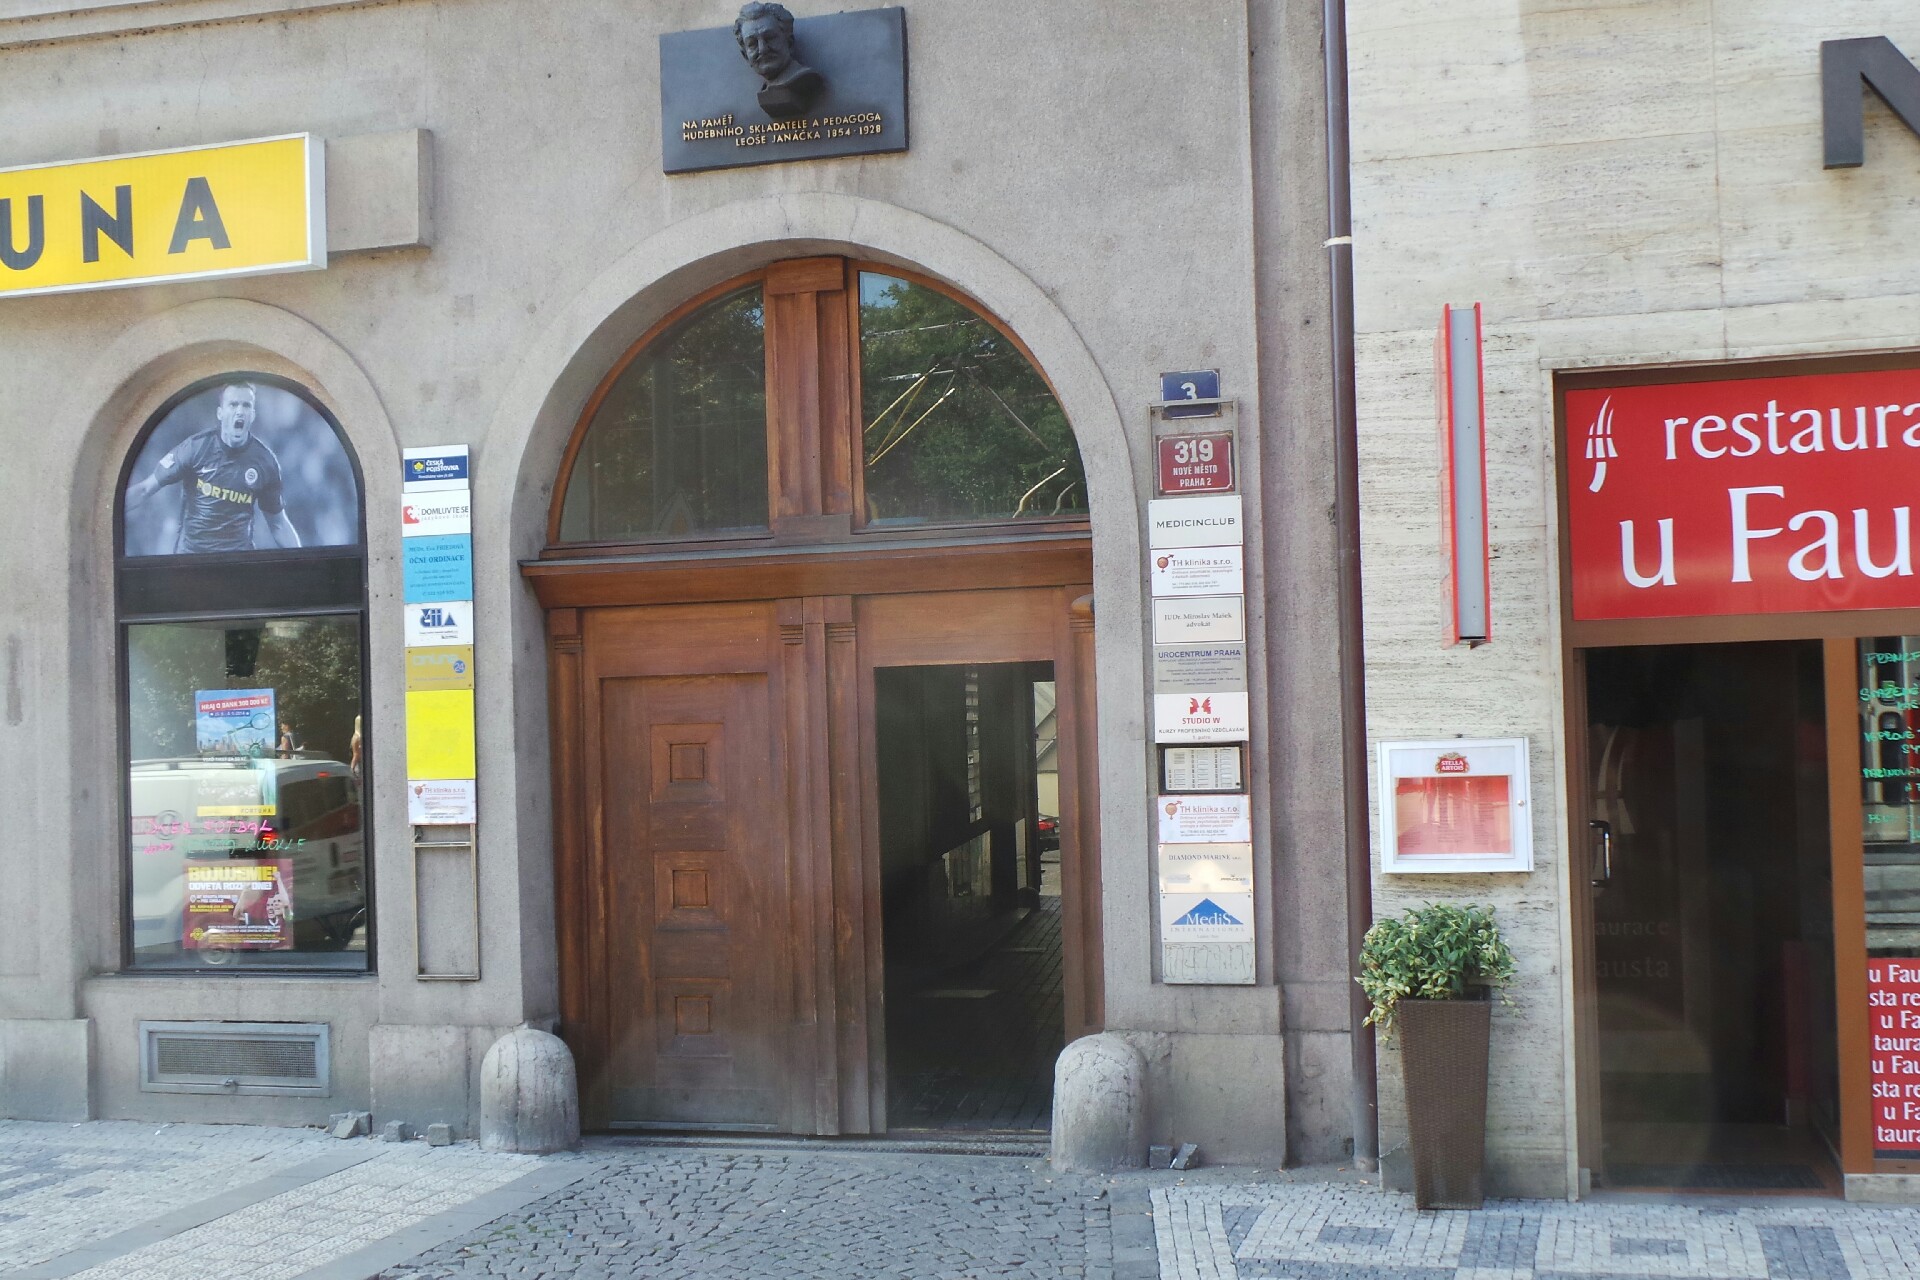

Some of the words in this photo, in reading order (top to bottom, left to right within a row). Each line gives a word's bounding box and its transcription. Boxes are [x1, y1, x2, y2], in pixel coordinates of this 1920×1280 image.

[683, 120, 697, 130] NA
[701, 114, 733, 128] PAMĚŤ
[683, 126, 744, 141] HUDEBNÍHO
[749, 119, 807, 134] SKLADATELE
[812, 118, 819, 127] A
[823, 113, 882, 126] PEDAGOGA
[735, 134, 766, 147] LEOŠE
[772, 130, 821, 143] JANÁČKA
[827, 128, 850, 138] 1854
[859, 125, 882, 135] 1928
[1180, 382, 1198, 400] 3
[1174, 439, 1214, 464] 319
[1173, 464, 1192, 476] NOVÉ
[1194, 463, 1217, 474] MĚSTO
[1180, 478, 1205, 487] PRAHA
[1207, 477, 1212, 486] 2
[196, 478, 252, 504] FORTUNA
[421, 507, 459, 515] DOMLUVTE
[1156, 518, 1235, 528] MEDICINCLUB
[1619, 518, 1677, 588] u
[1728, 485, 1914, 582] Fau
[1172, 559, 1183, 567] TH
[1158, 650, 1212, 658] UROCENTRUM
[1186, 912, 1231, 925] MediS
[1869, 969, 1881, 983] u
[1888, 964, 1920, 983] Fau
[1869, 990, 1897, 1006] sta
[1880, 1014, 1893, 1029] u
[1900, 1010, 1920, 1029] Fa
[1872, 1060, 1884, 1074] u
[1872, 1081, 1900, 1098] sta
[1883, 1105, 1896, 1120] u
